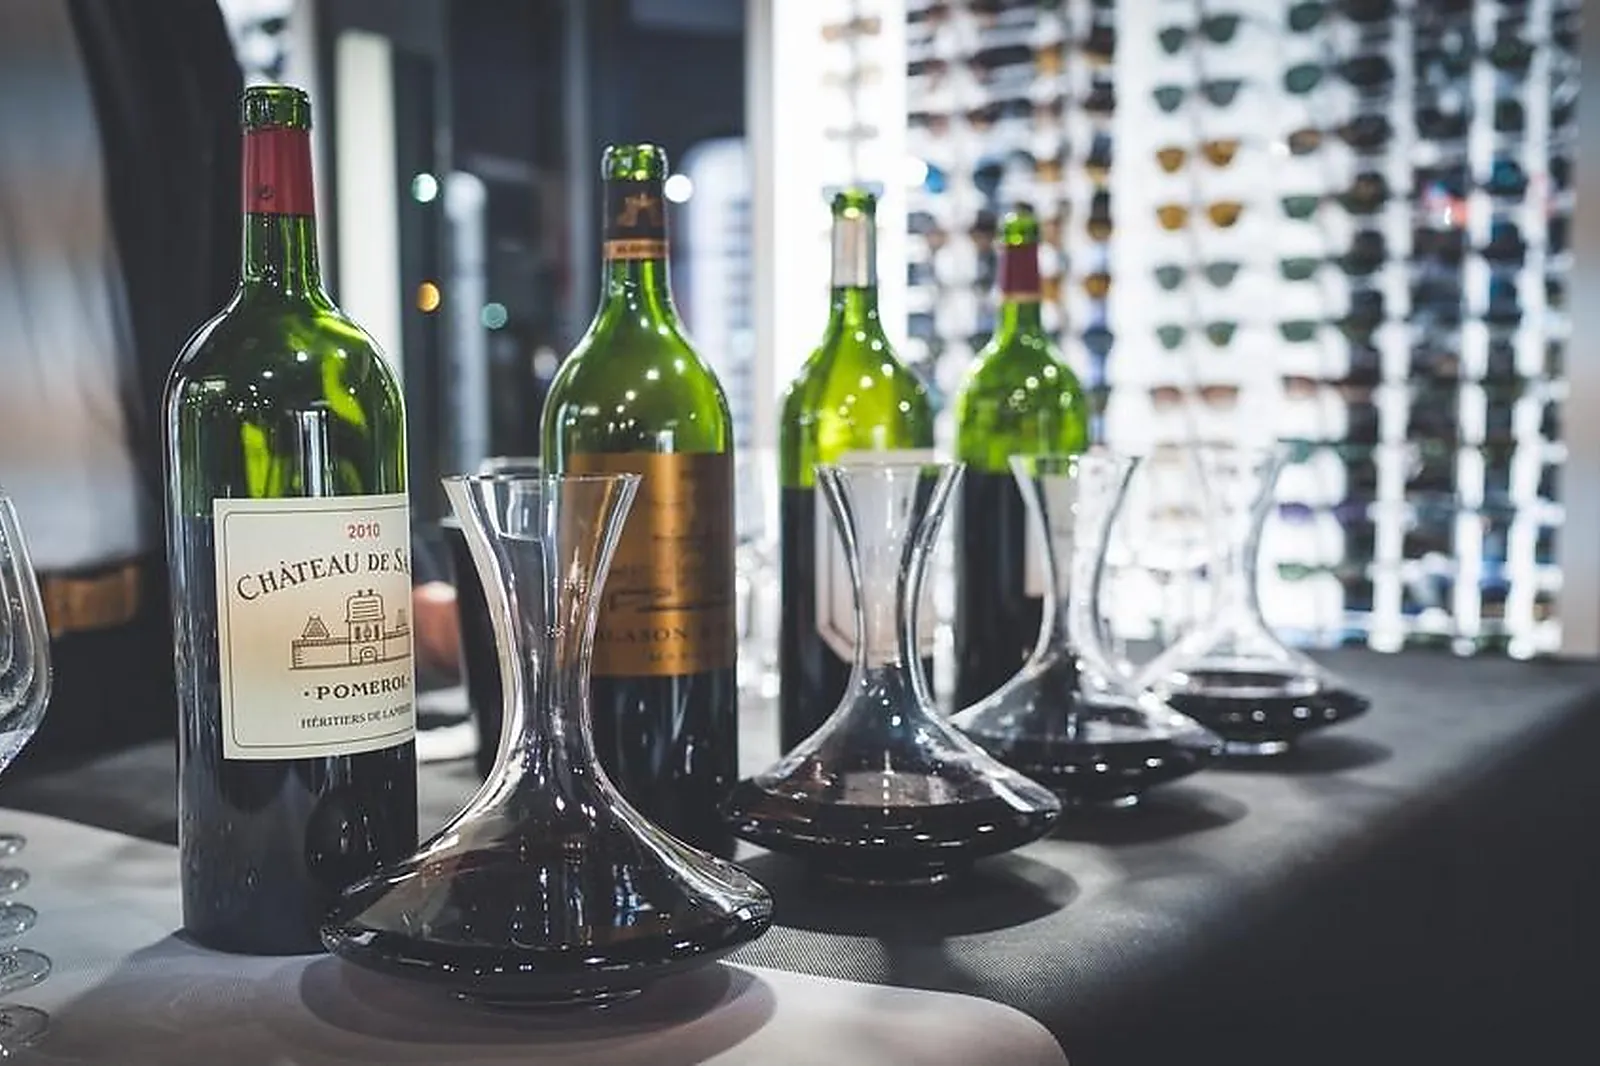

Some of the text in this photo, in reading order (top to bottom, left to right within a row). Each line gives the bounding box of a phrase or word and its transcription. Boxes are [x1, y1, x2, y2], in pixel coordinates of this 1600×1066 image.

[347, 523, 380, 539] 2010
[368, 552, 390, 571] DE
[315, 674, 407, 700] POMEROL
